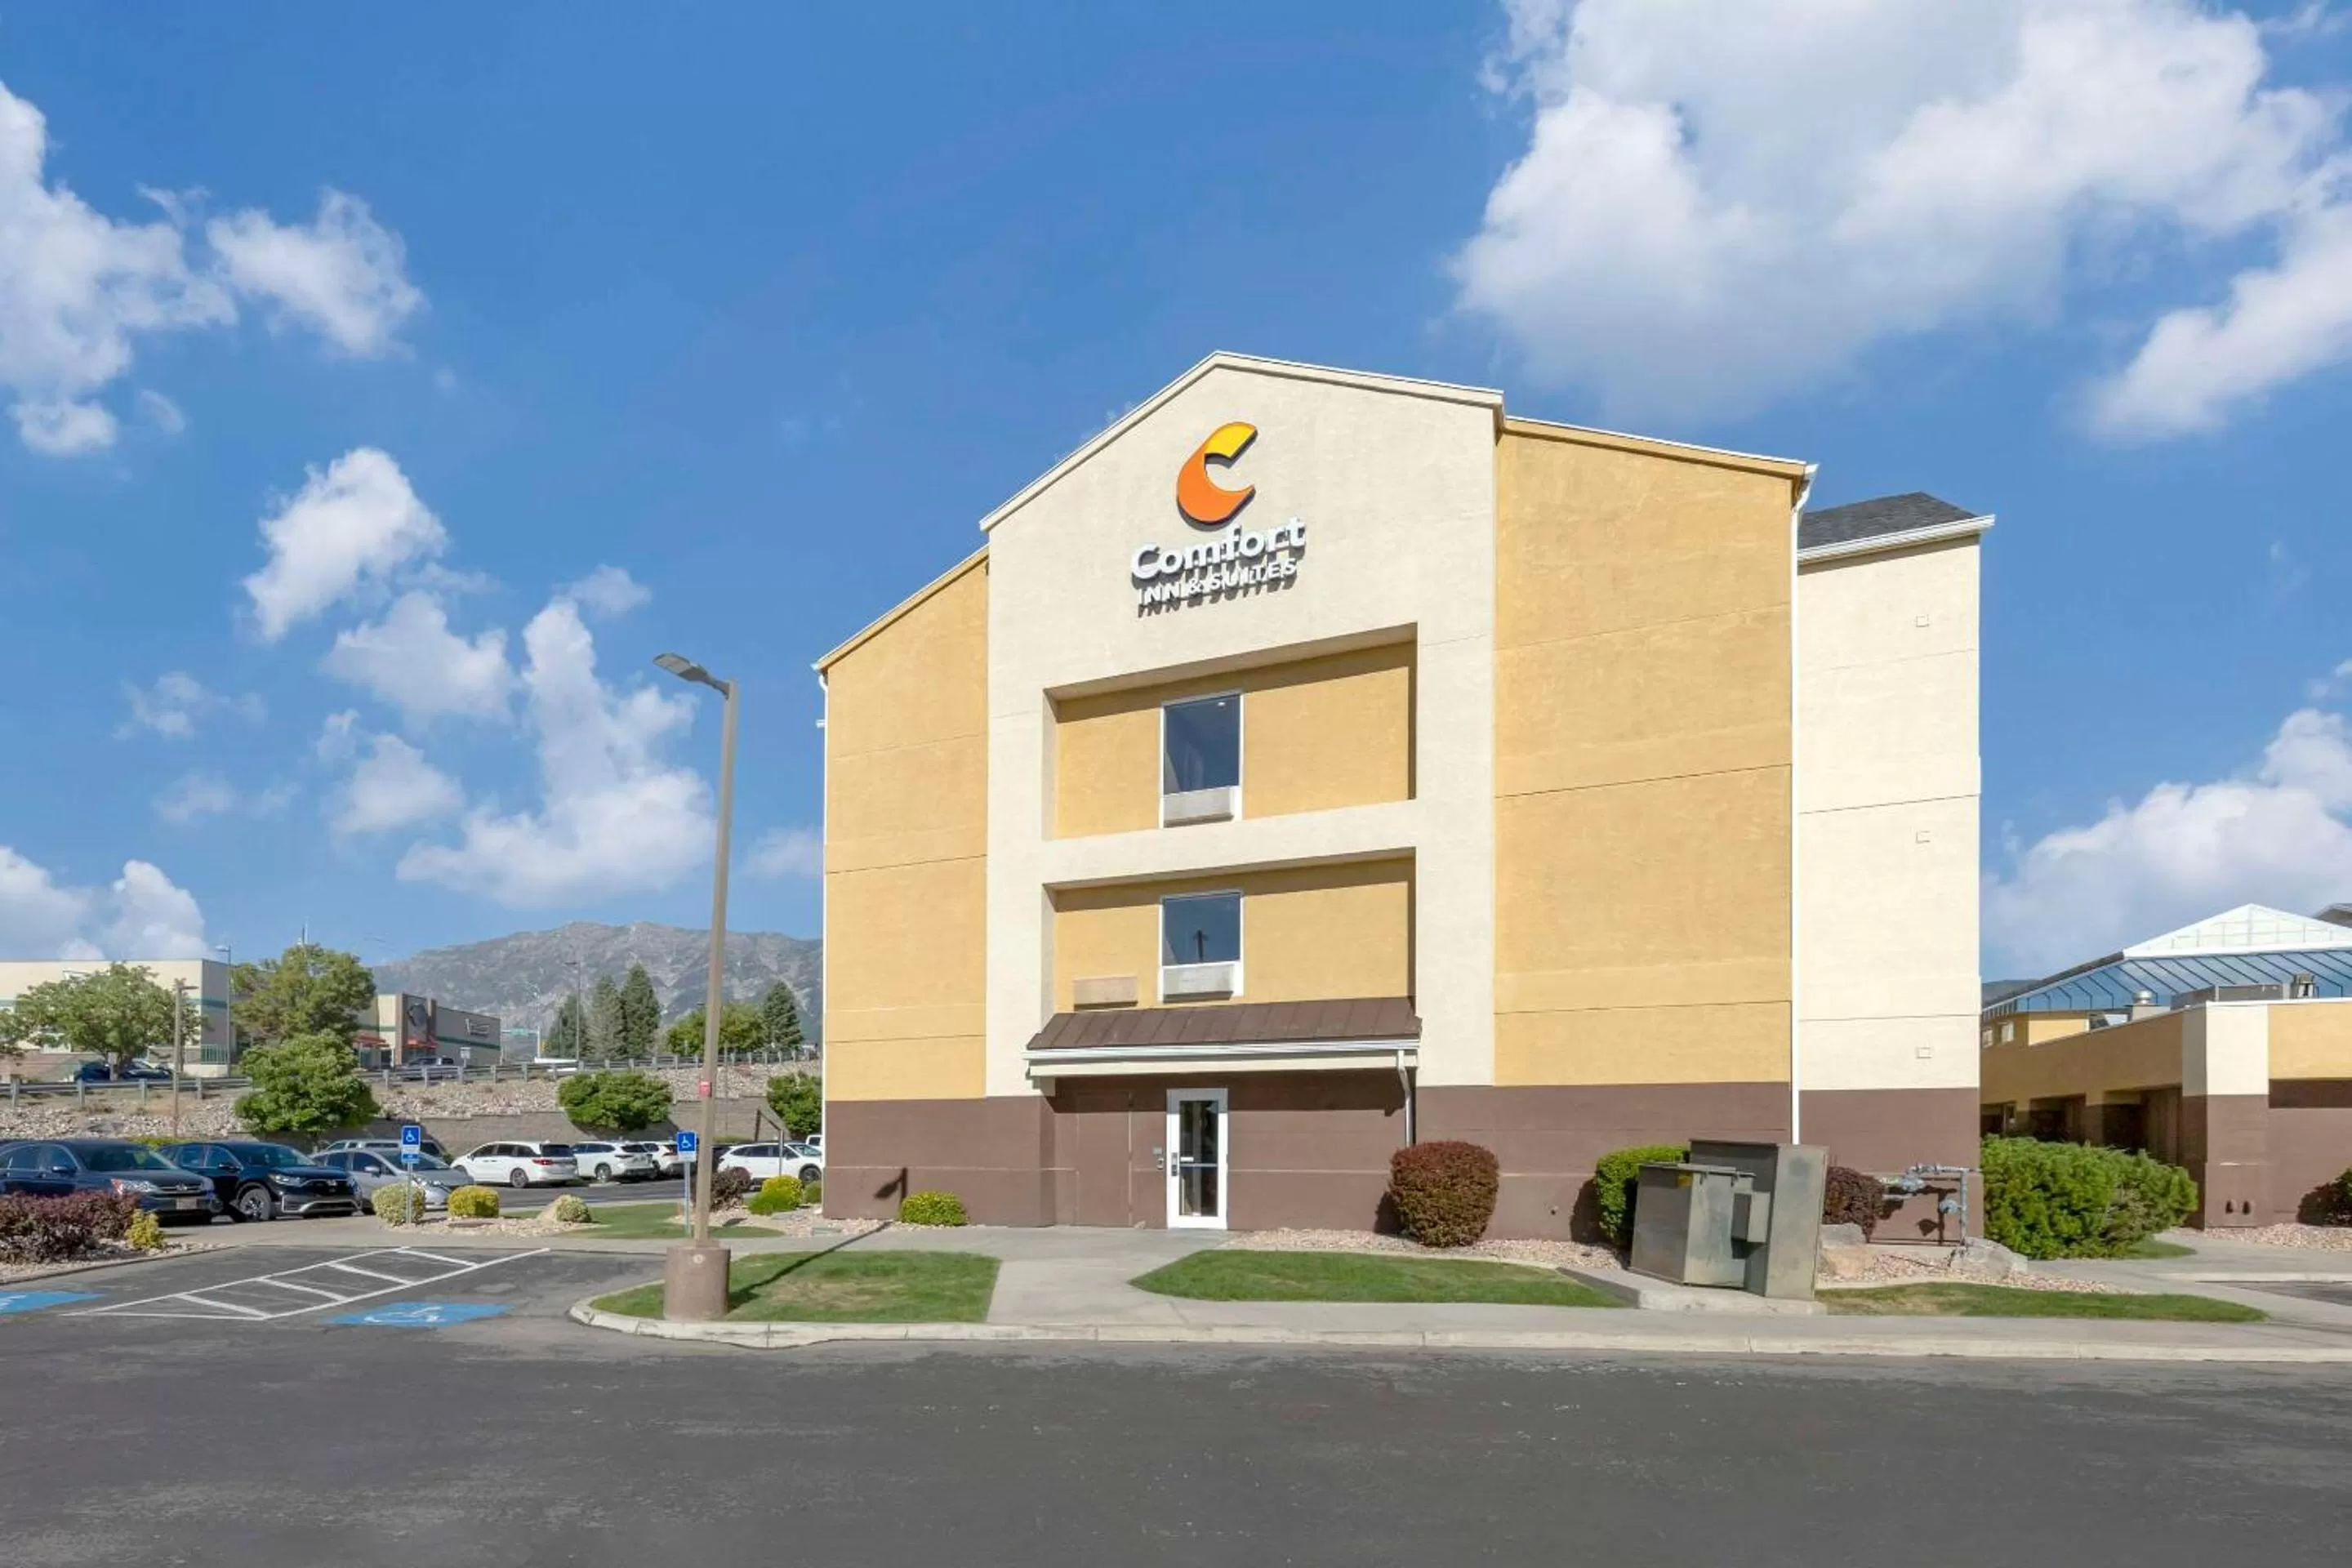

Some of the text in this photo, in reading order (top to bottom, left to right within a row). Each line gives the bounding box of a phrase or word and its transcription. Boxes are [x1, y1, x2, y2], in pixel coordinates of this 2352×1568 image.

[1131, 518, 1305, 579] Comfort
[1139, 581, 1181, 605] INN
[1209, 559, 1297, 590] SUITES
